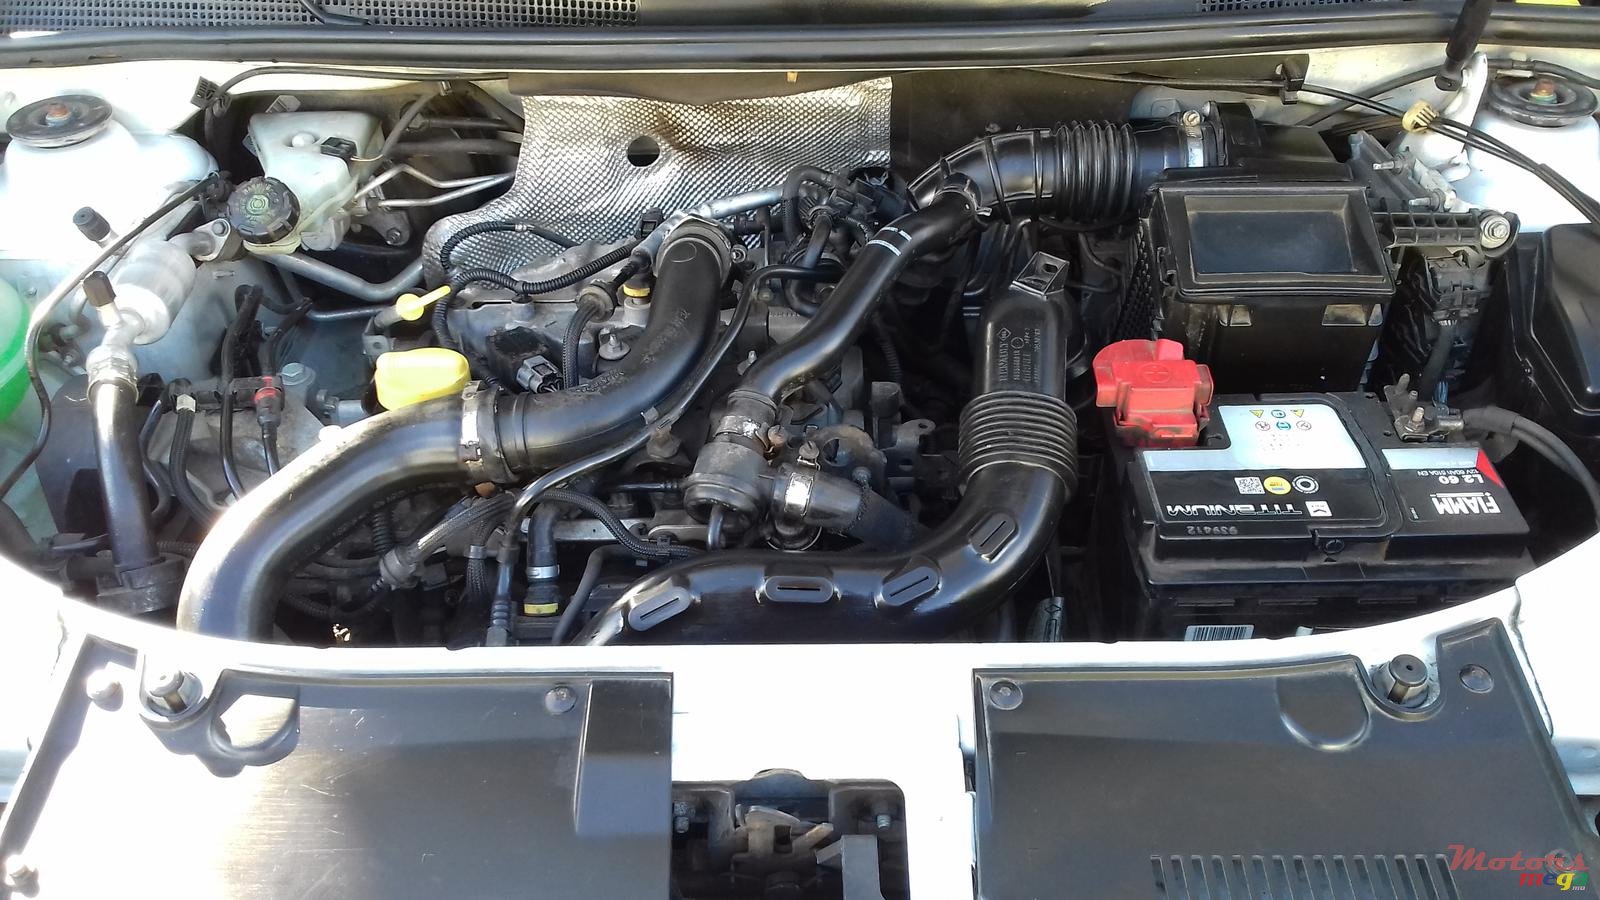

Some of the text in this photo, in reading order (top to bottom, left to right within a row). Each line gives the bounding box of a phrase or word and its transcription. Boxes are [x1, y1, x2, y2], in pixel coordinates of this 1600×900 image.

[1438, 474, 1484, 484] L2 60
[1166, 503, 1303, 516] TITANIUM
[1430, 496, 1501, 515] FIAMM
